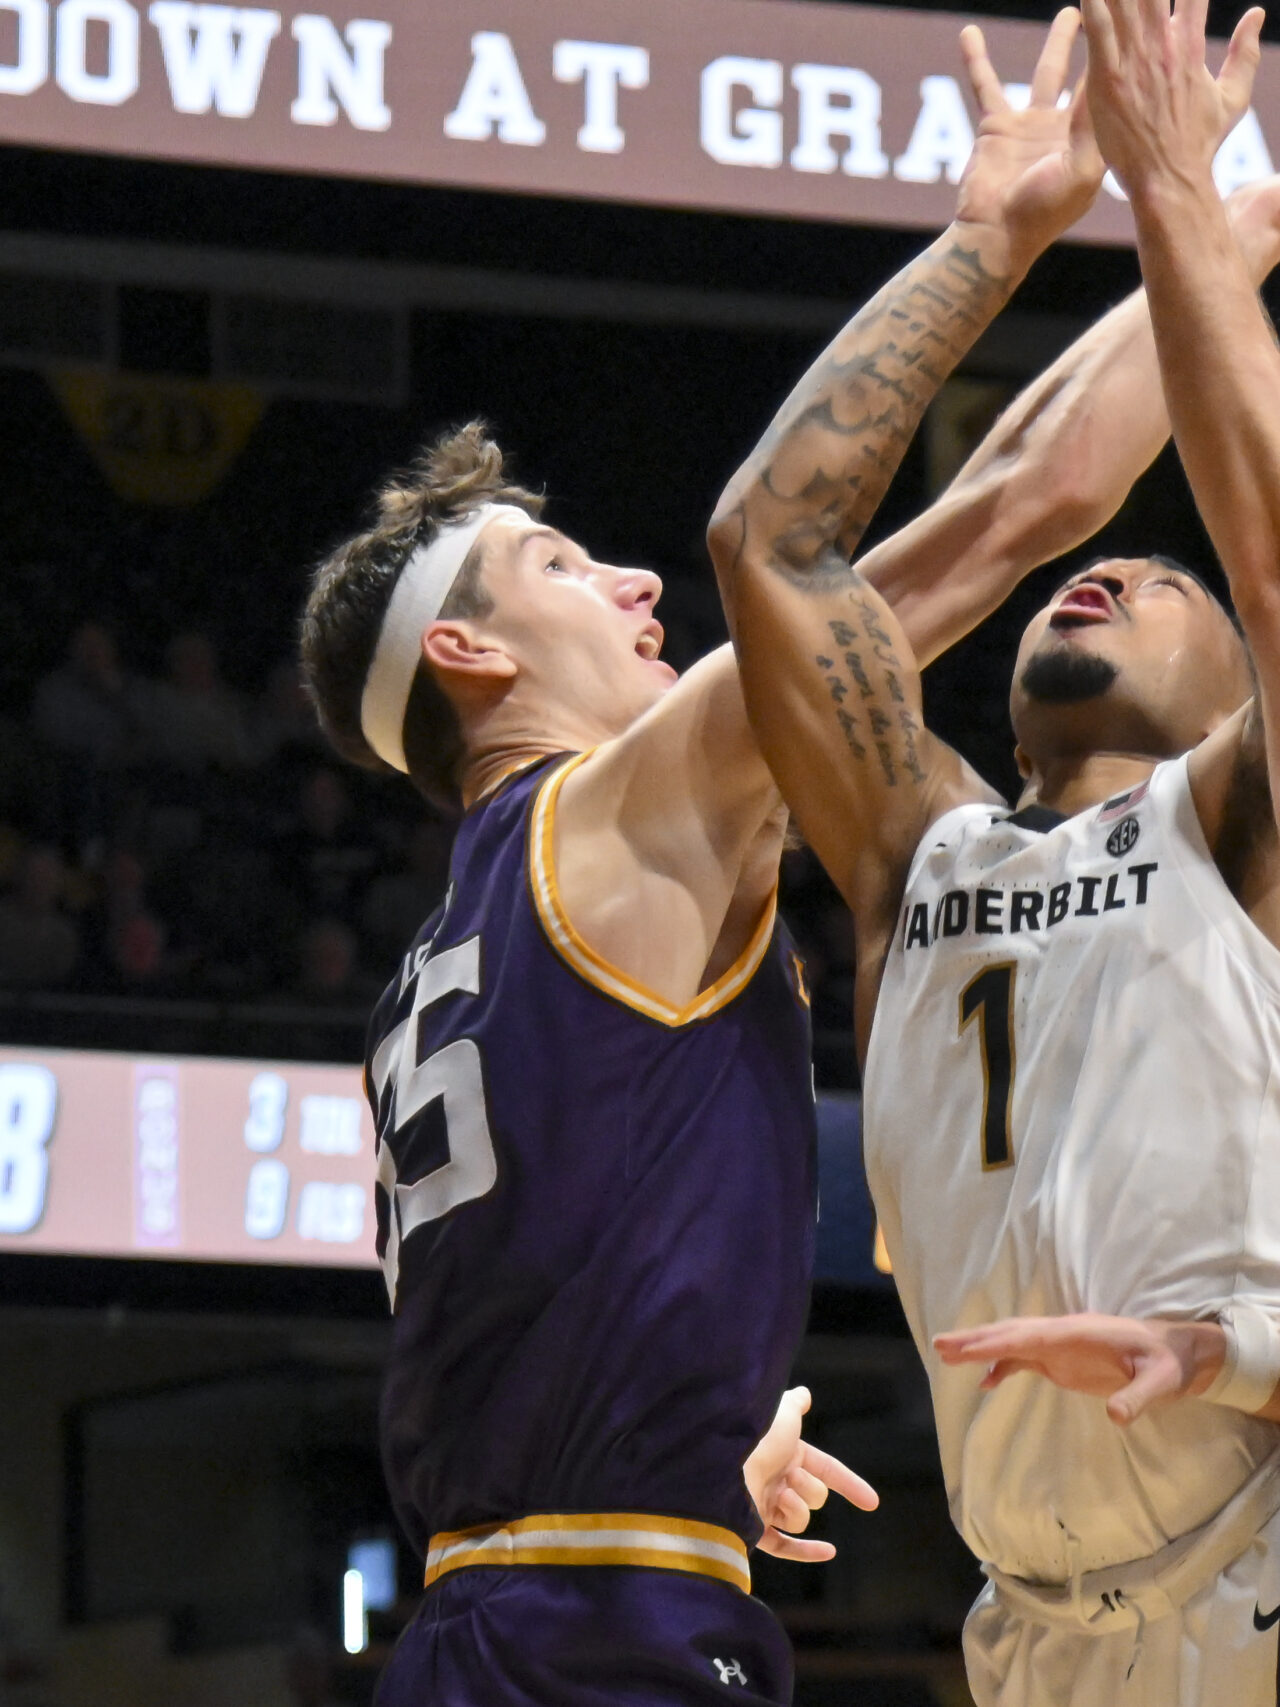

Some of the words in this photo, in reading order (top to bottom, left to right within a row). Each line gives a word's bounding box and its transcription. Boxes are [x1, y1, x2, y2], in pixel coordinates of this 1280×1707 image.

[444, 32, 649, 153] AT
[1109, 819, 1139, 854] SEC
[902, 862, 1159, 950] ADERBILT
[957, 959, 1018, 1173] 1
